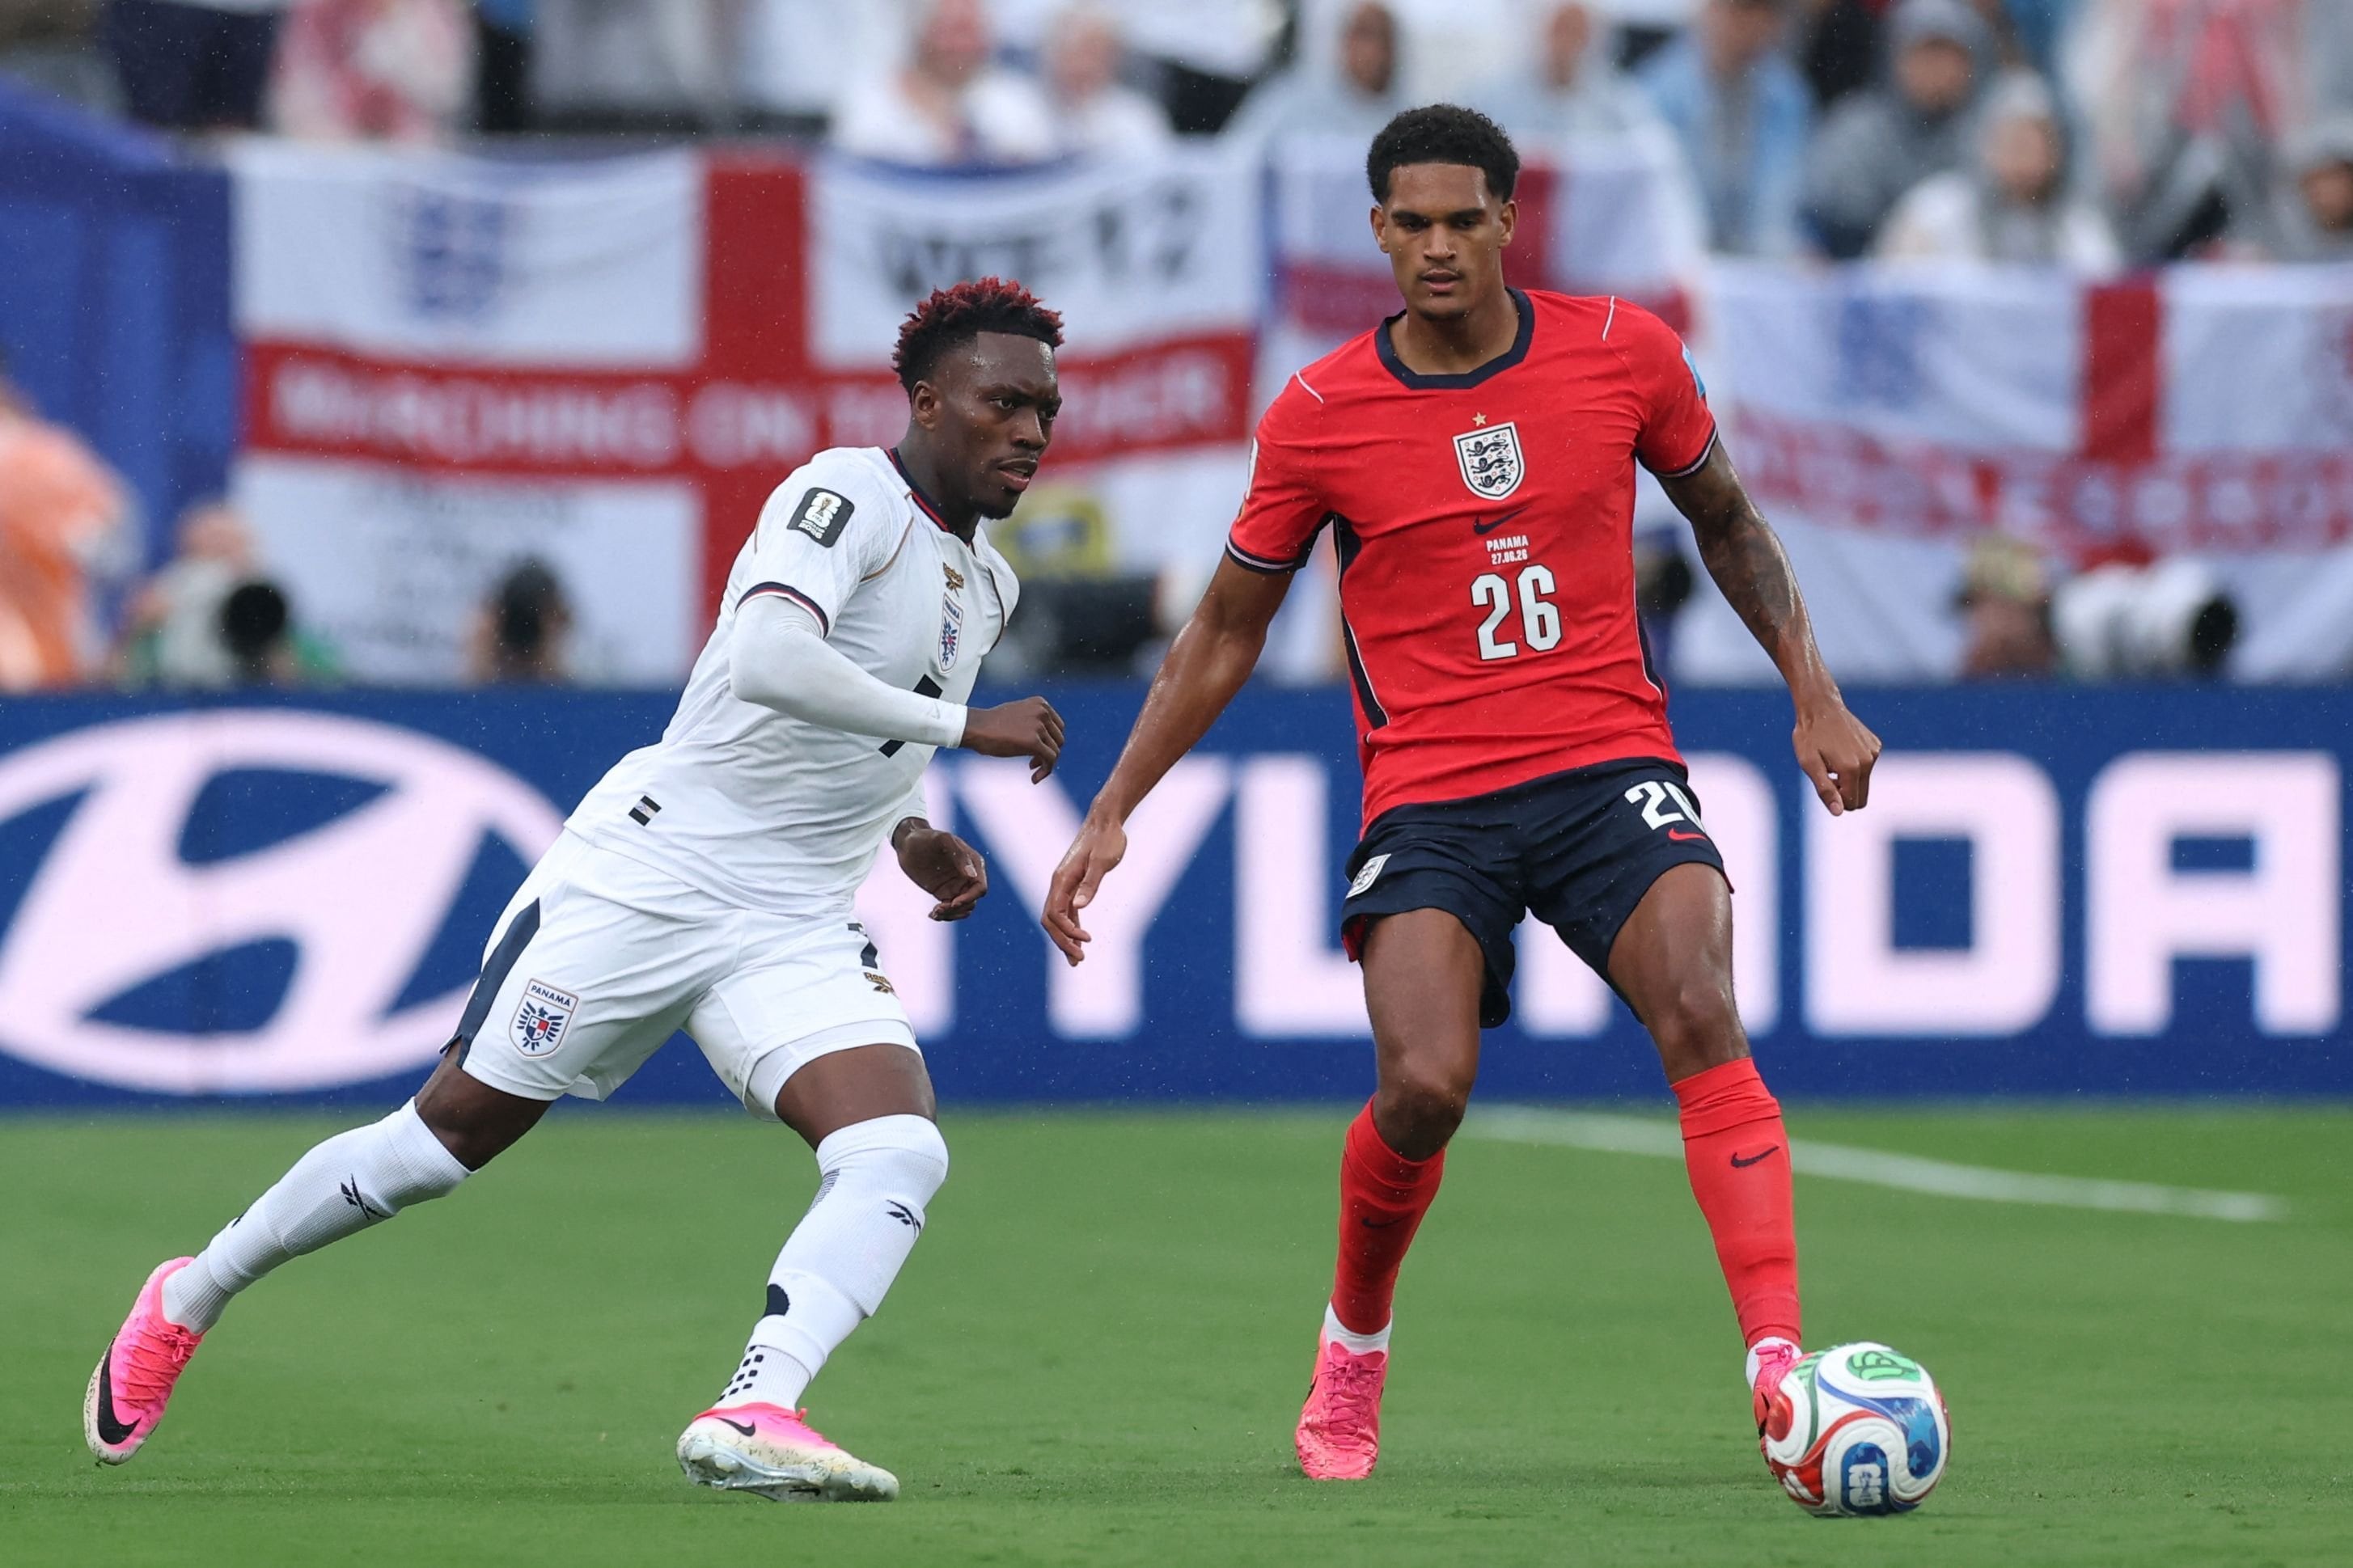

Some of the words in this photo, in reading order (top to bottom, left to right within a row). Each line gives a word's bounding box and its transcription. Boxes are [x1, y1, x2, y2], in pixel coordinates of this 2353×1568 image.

[828, 351, 1228, 451] TOHER
[1486, 535, 1529, 552] PANAMA
[1470, 564, 1563, 660] 26
